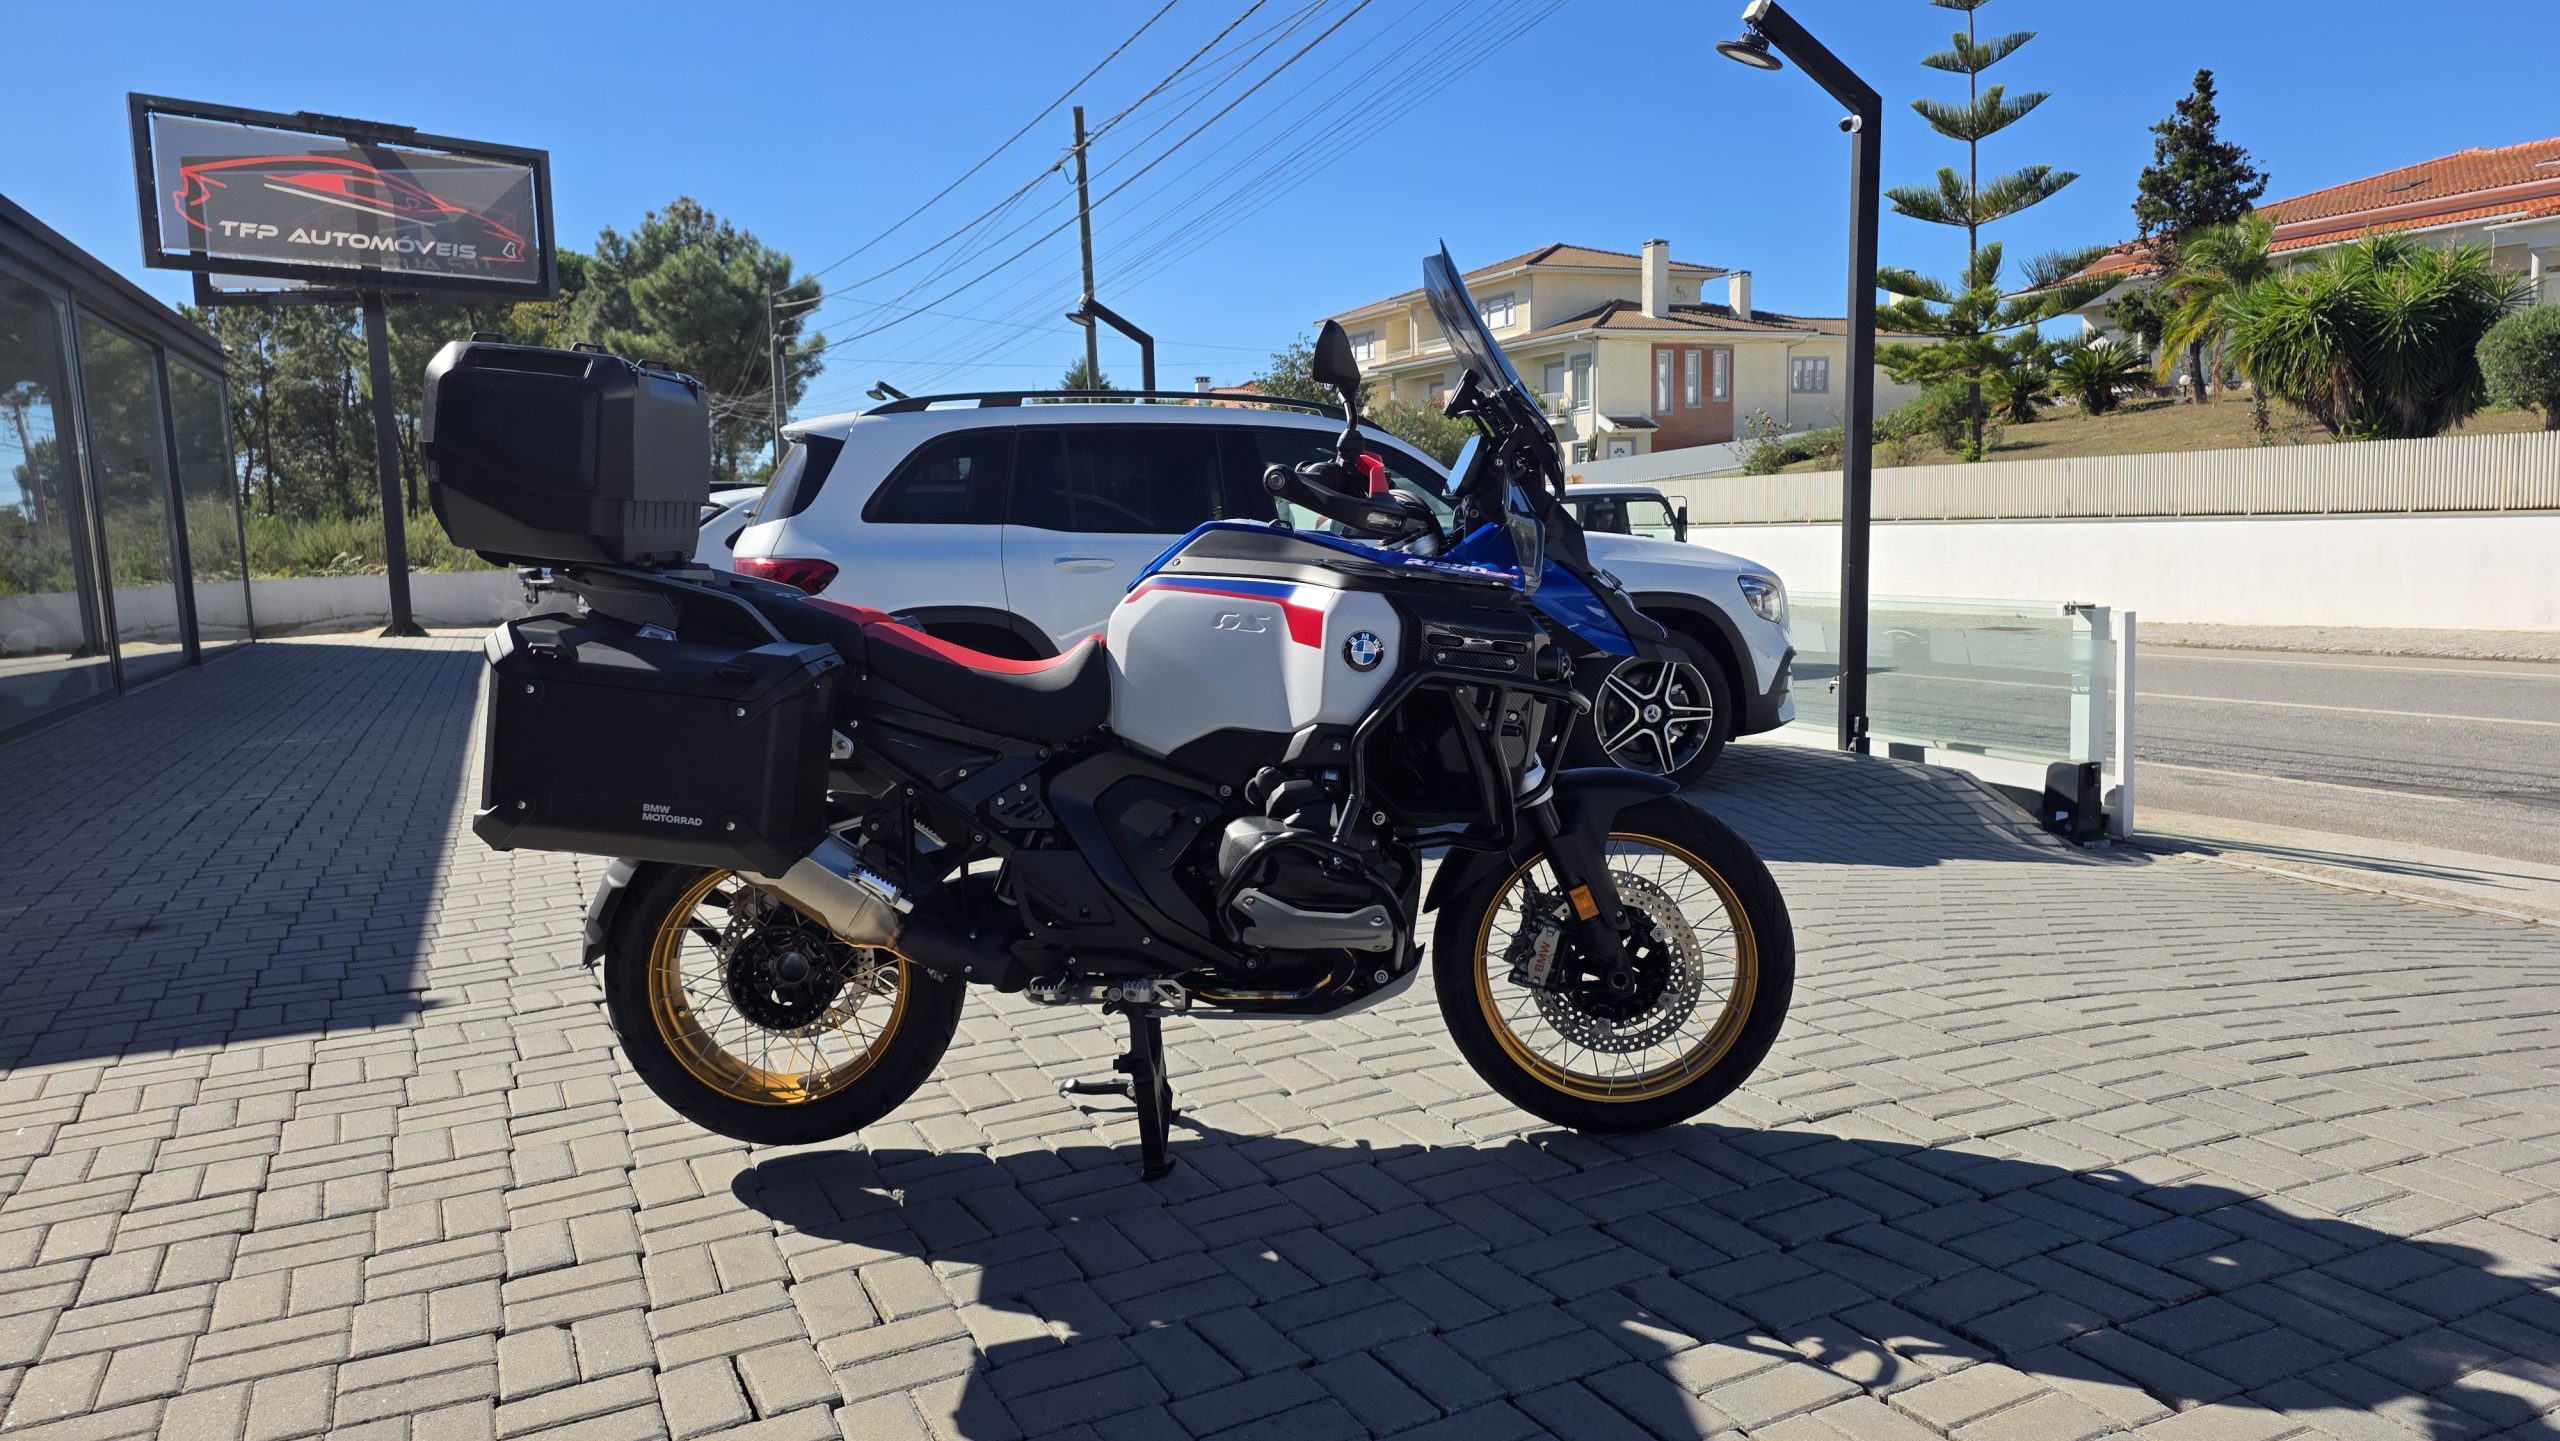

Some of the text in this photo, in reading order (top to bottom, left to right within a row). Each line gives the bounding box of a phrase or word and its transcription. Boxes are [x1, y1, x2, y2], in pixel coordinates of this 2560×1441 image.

[219, 220, 477, 259] TFP AUTOMÓVEIS
[1210, 610, 1271, 633] GS
[1349, 632, 1384, 652] BMW
[642, 812, 703, 826] MOTORRAD
[643, 803, 670, 814] BMW
[1535, 941, 1550, 973] BMW
